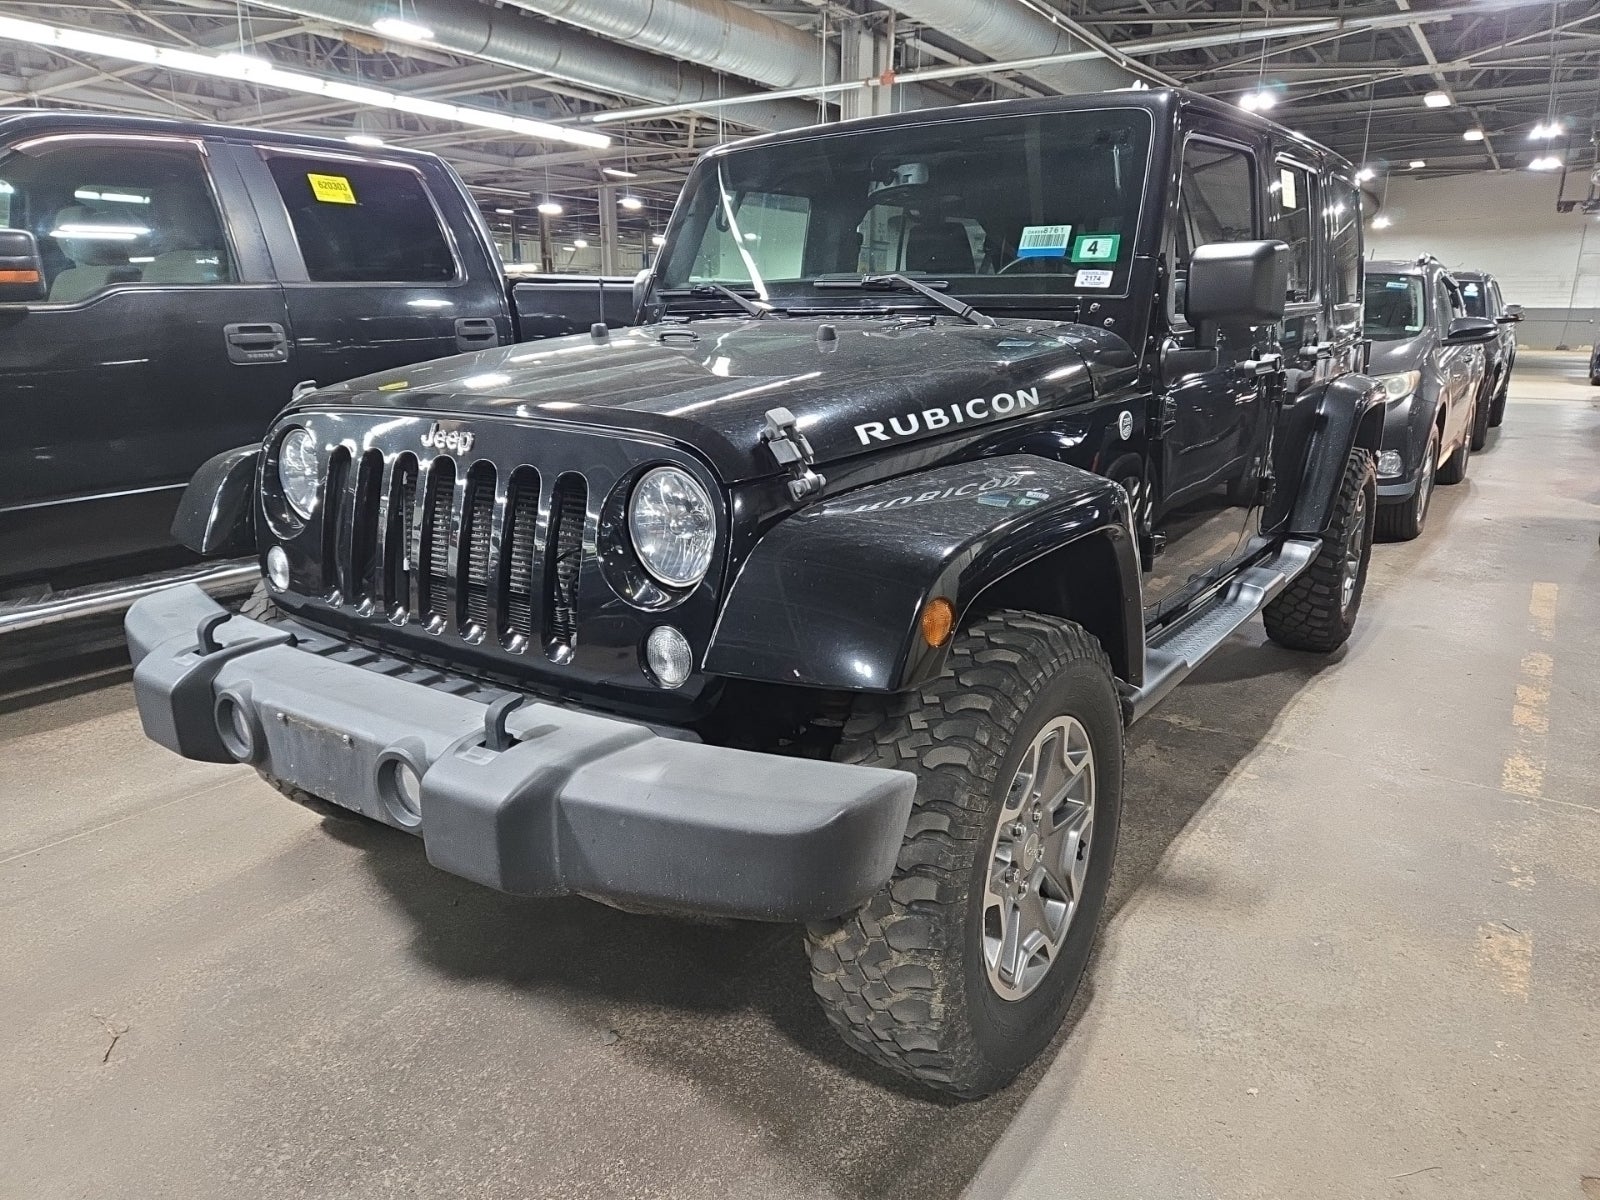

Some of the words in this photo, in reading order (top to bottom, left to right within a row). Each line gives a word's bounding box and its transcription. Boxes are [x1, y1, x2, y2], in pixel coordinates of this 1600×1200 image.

[317, 180, 348, 191] 620303
[1087, 240, 1099, 255] 4
[853, 387, 1040, 446] RUBICON
[420, 422, 475, 456] Jeep
